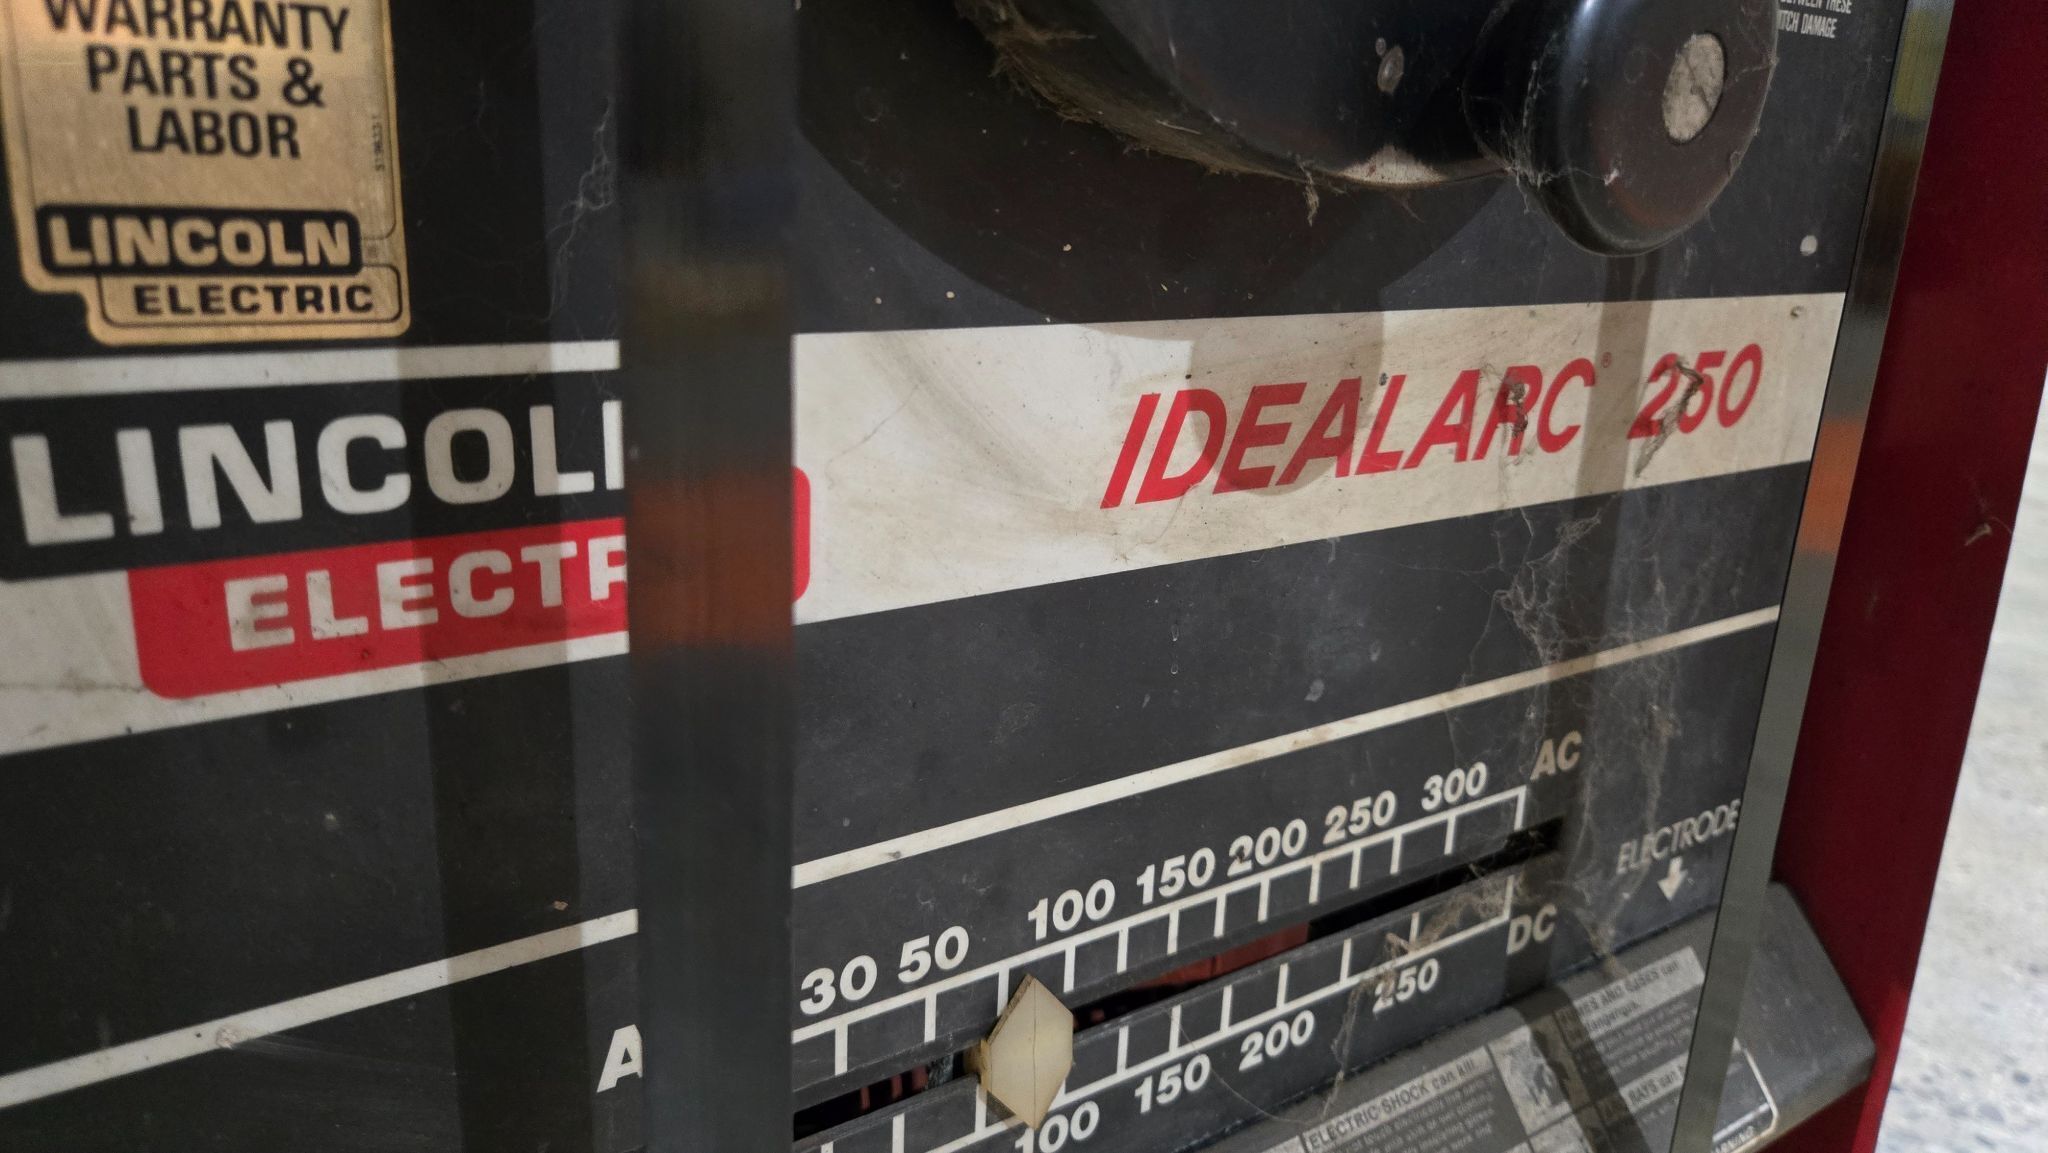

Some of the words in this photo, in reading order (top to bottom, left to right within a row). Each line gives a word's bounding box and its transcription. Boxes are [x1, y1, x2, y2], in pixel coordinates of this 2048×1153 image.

[46, 0, 348, 51] WARRANTY
[1800, 13, 1838, 38] DAMAGE
[86, 45, 260, 100] PARTS
[282, 57, 326, 107] &
[127, 106, 301, 160] LABOR
[50, 213, 351, 268] LINCOLN
[133, 284, 373, 316] ELECTRIC
[1100, 357, 1596, 509] IDEALARC
[1626, 343, 1763, 441] 250
[11, 400, 625, 547] LINCOL
[224, 534, 627, 652] ELECTR
[1530, 730, 1582, 781] AC
[1616, 798, 1741, 875] ELECTRODE
[799, 954, 878, 1016] 30
[898, 926, 970, 983] 50
[1028, 879, 1116, 941] 100
[1136, 846, 1216, 904] 150
[1226, 818, 1307, 878] 200
[1324, 791, 1397, 842] 250
[1420, 761, 1488, 812] 300
[1506, 905, 1559, 956] DC
[1014, 1100, 1100, 1153] 100
[1134, 1053, 1211, 1114] 150
[1238, 1009, 1316, 1072] 200
[1372, 957, 1440, 1014] 250
[1309, 1104, 1379, 1150] ELECTRIC
[1380, 1080, 1430, 1116] SHOCK
[1431, 1071, 1455, 1090] can
